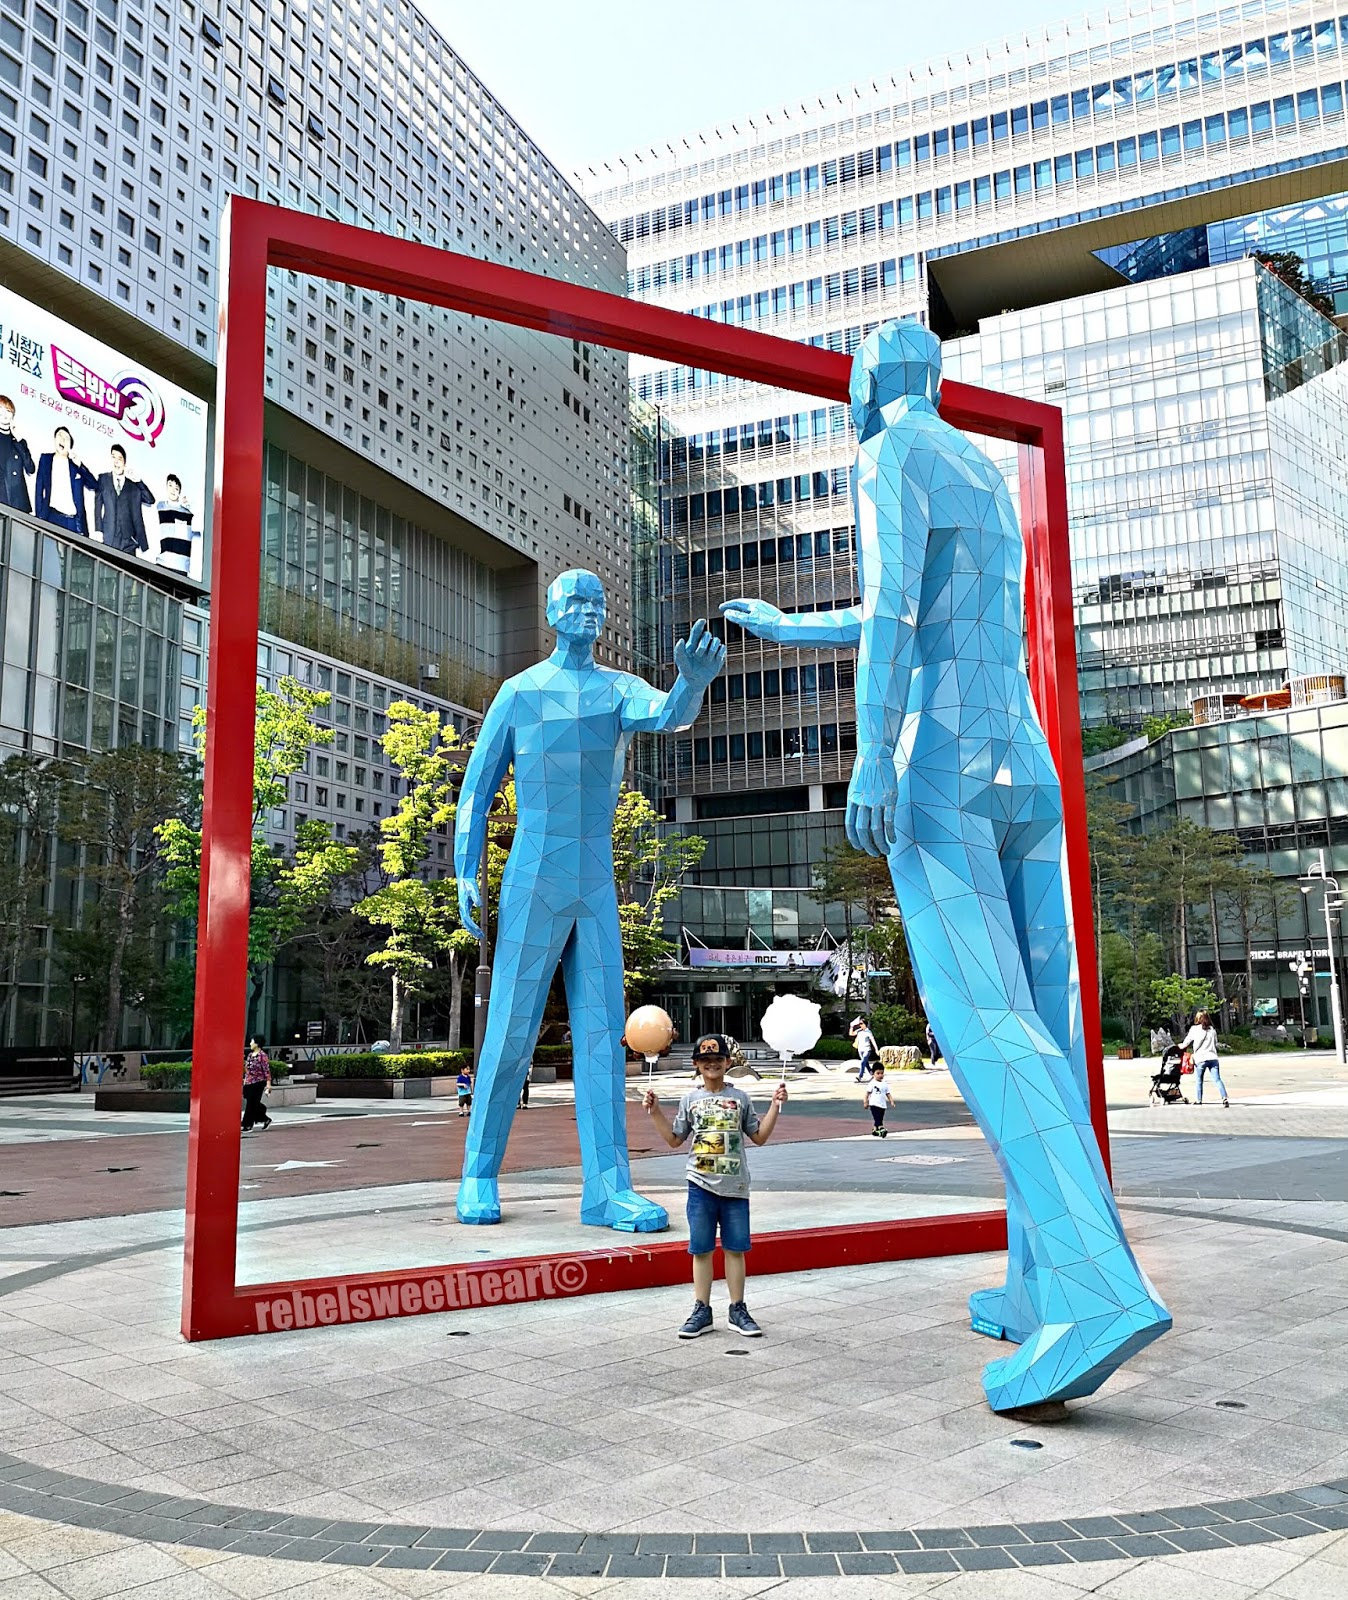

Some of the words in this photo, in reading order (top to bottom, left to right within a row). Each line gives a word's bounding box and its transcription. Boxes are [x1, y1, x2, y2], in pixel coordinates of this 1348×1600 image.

[8, 329, 45, 361] 시청자
[9, 347, 43, 379] 퀴즈쇼
[55, 349, 121, 415] 뜻밖의
[755, 955, 777, 963] MBC
[1305, 949, 1330, 957] STOR
[716, 984, 740, 992] MBC
